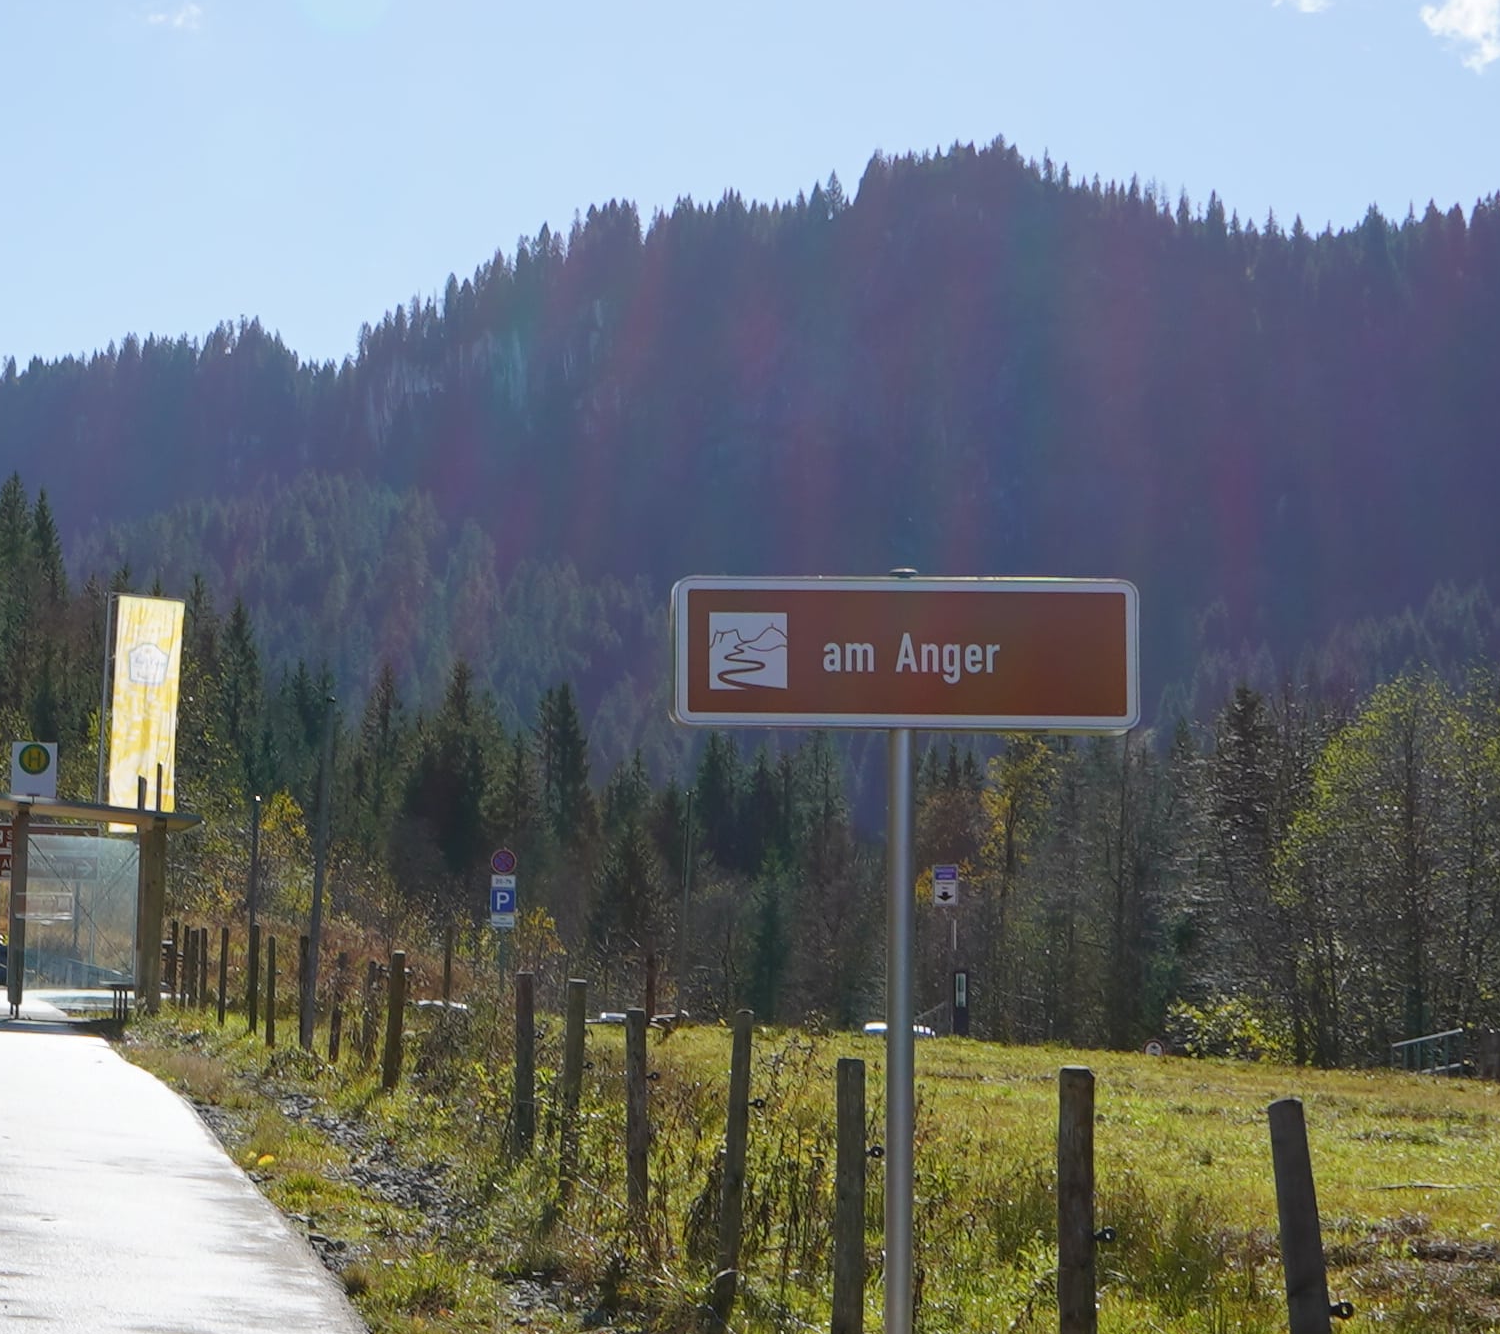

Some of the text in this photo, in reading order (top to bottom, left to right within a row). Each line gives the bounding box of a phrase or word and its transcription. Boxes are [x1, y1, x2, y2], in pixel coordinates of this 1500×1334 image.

[823, 632, 1001, 685] am Anger
[28, 750, 41, 768] H
[496, 891, 510, 911] P
